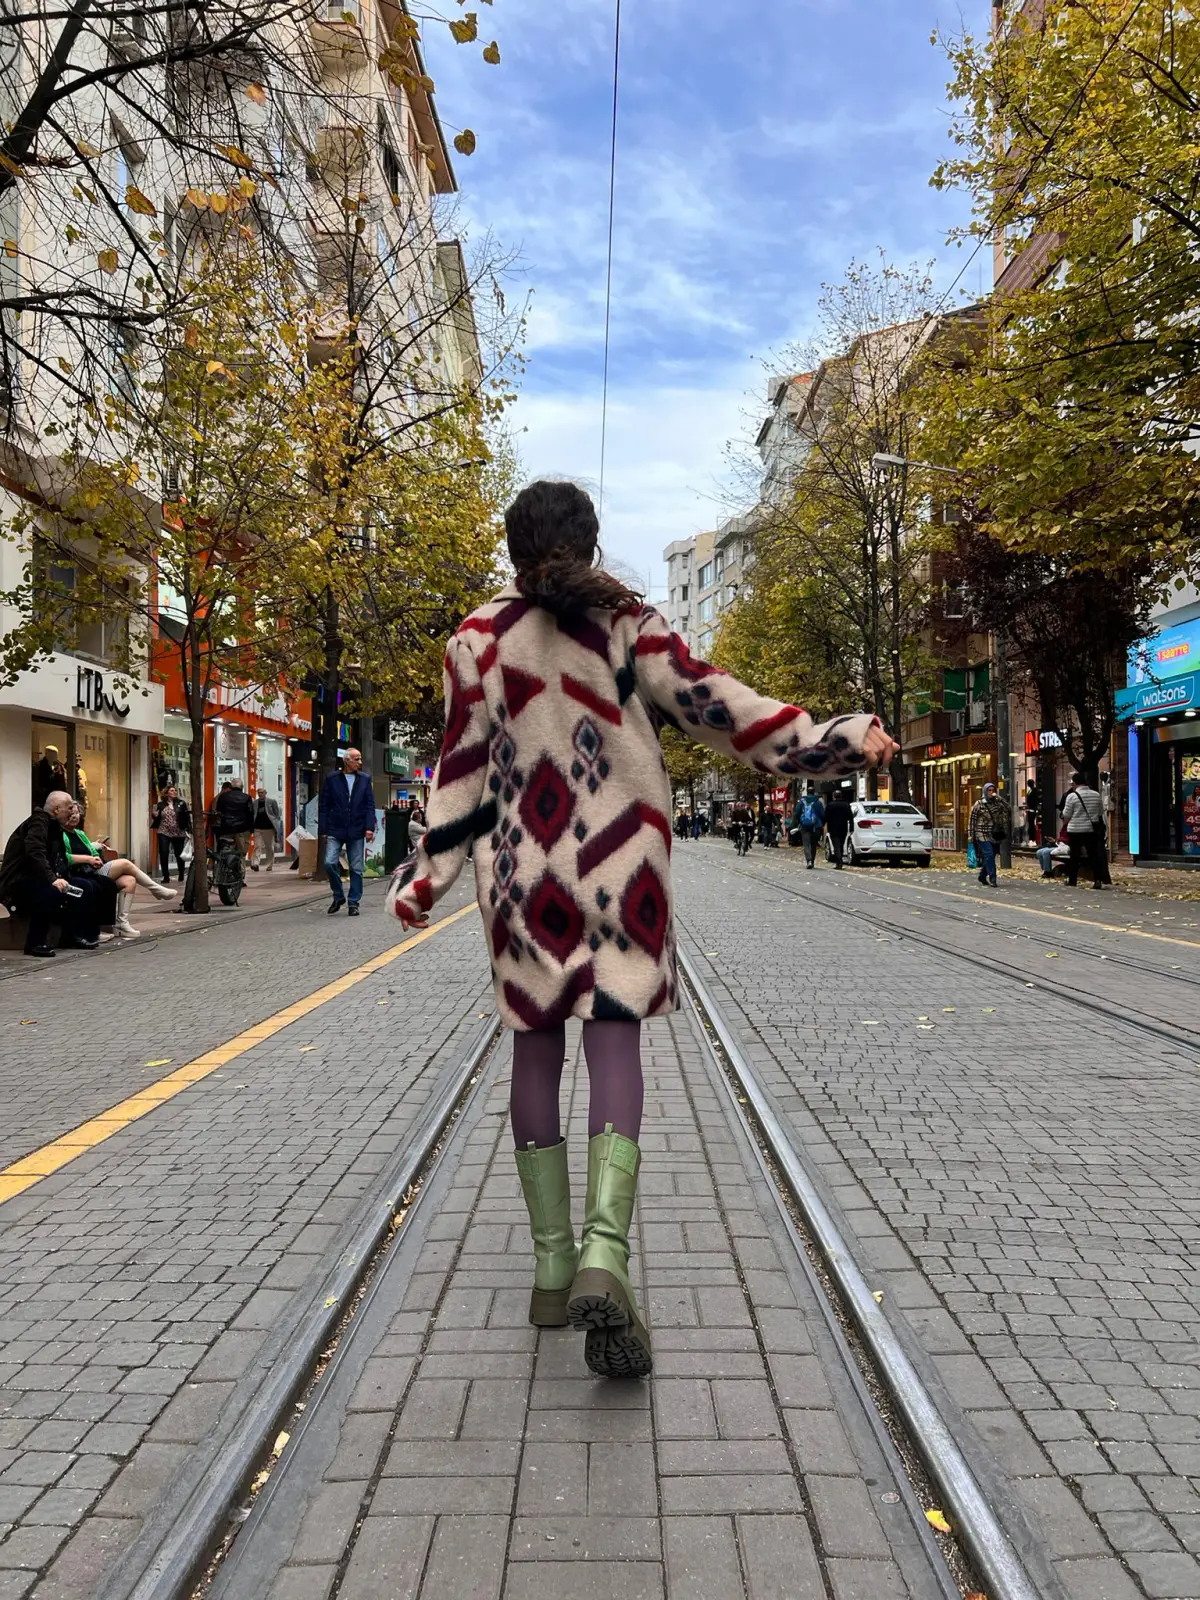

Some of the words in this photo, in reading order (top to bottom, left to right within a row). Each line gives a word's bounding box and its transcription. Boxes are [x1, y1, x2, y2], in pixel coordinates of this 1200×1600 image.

[77, 665, 104, 712] LTB
[1142, 685, 1187, 706] watsons
[84, 734, 105, 752] LTB
